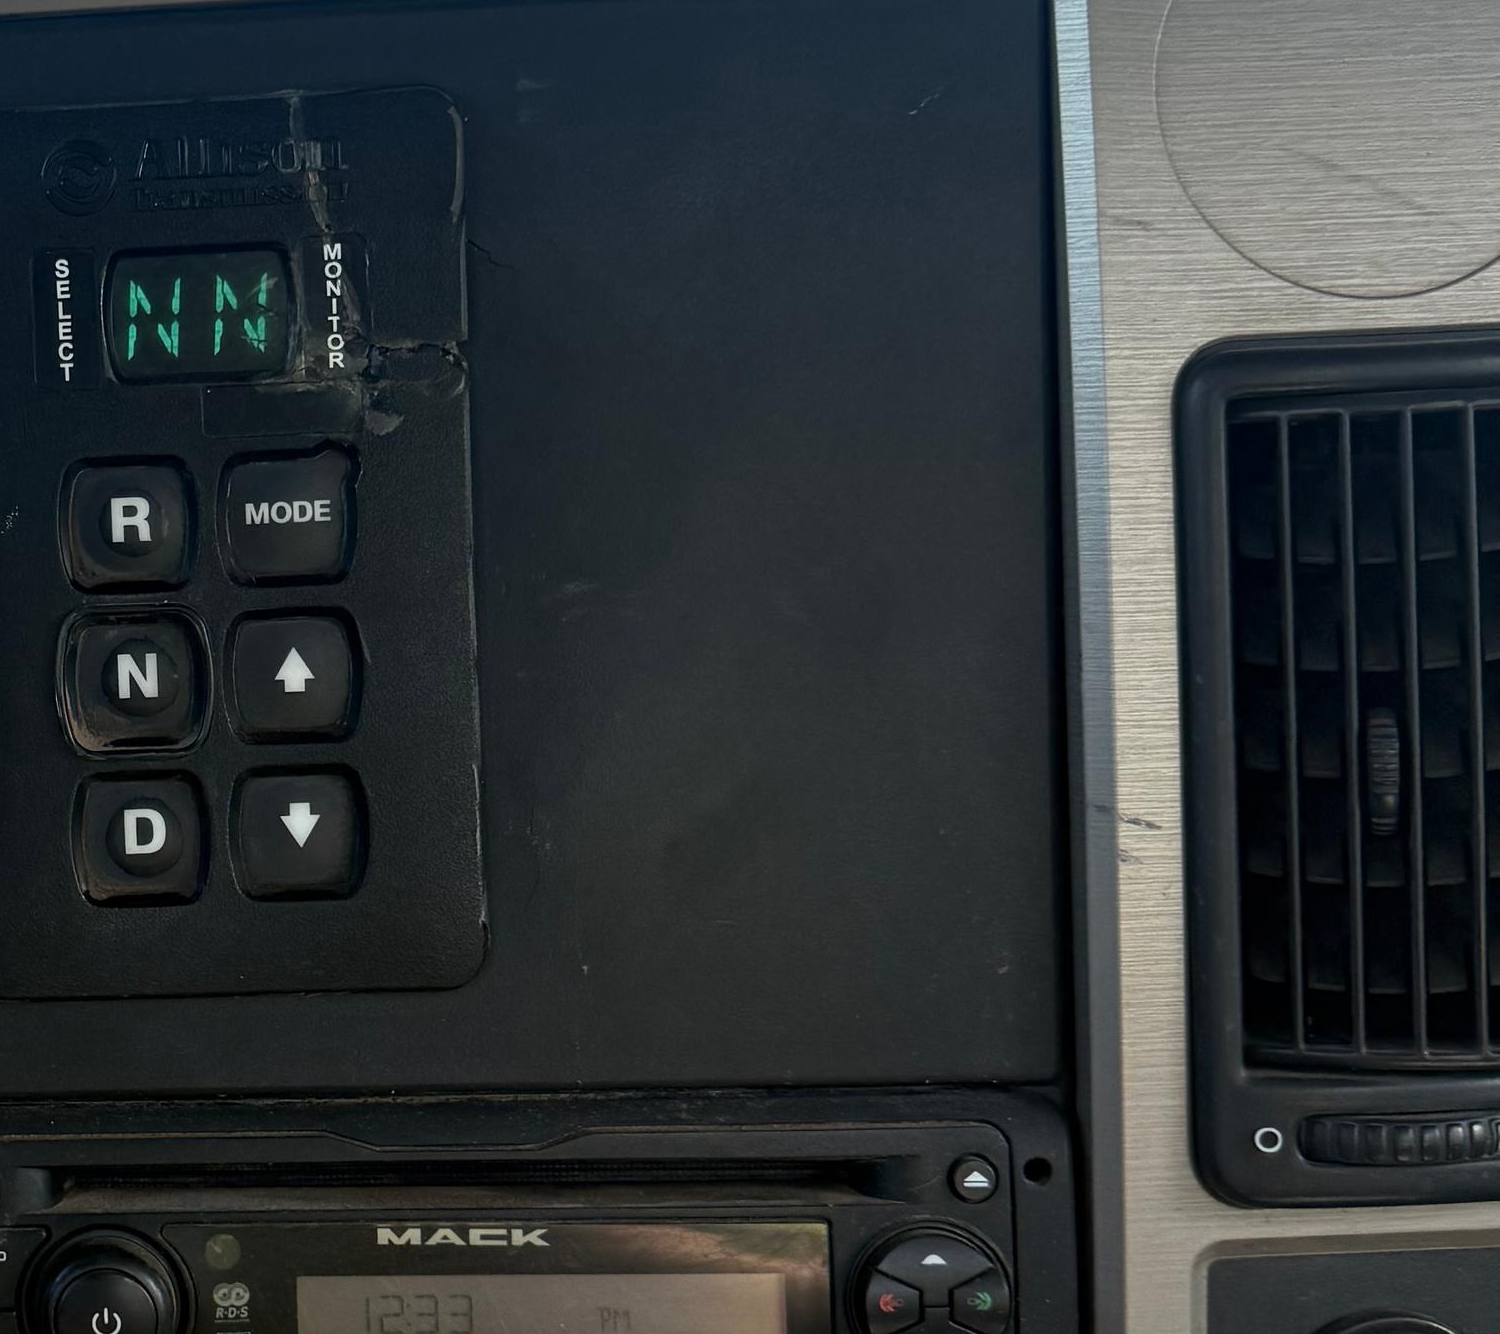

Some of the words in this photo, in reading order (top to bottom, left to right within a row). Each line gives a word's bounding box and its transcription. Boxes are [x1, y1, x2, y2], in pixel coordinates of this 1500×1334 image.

[55, 258, 73, 382] SELECT
[323, 243, 345, 368] MONITOR
[111, 497, 152, 543] R
[244, 499, 331, 525] MODE
[116, 653, 158, 699] N
[124, 808, 166, 855] D
[376, 1227, 551, 1247] MACK
[365, 1294, 473, 1334] 12:33
[597, 1306, 631, 1332] PM
